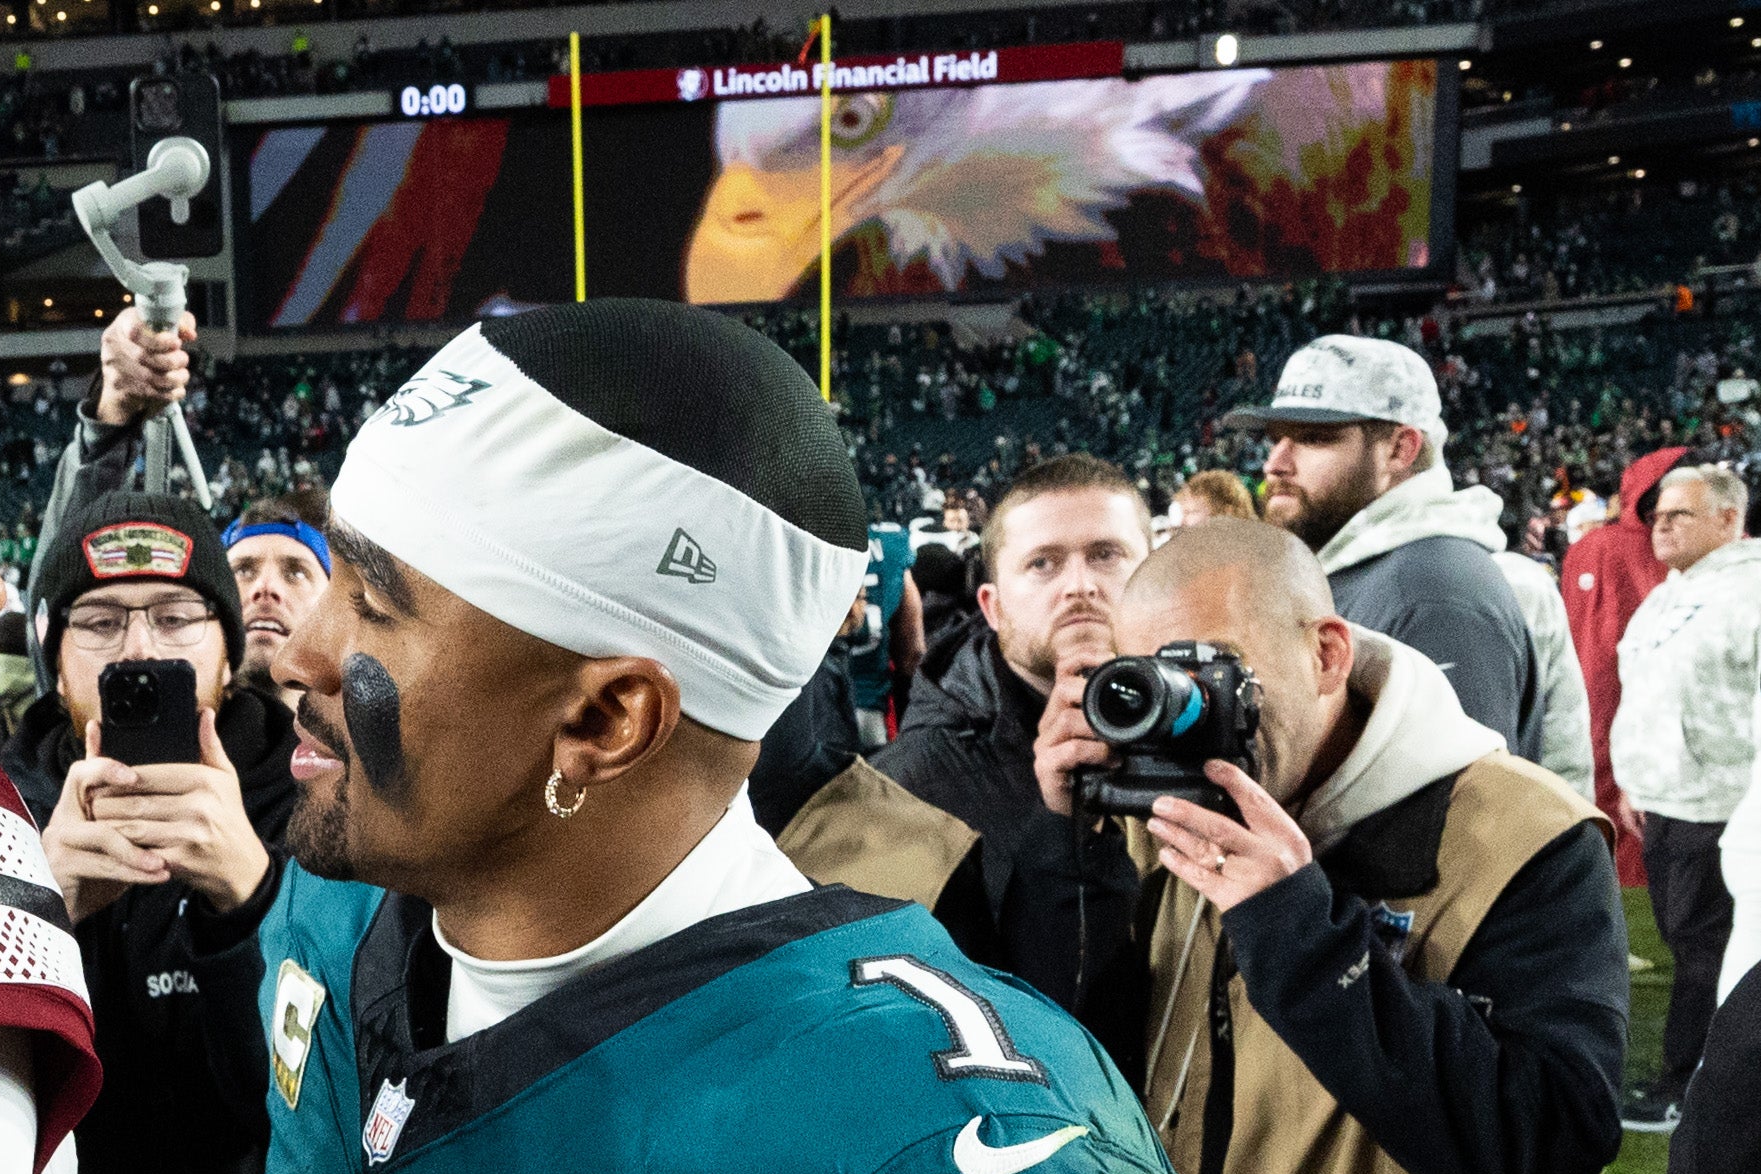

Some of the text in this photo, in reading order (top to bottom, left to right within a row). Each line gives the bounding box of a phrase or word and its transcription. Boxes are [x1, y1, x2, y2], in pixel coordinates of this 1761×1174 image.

[713, 50, 998, 96] Lincoln Financial Field
[401, 85, 466, 116] 0:00
[848, 954, 1048, 1087] 1
[367, 1111, 397, 1151] NFL
